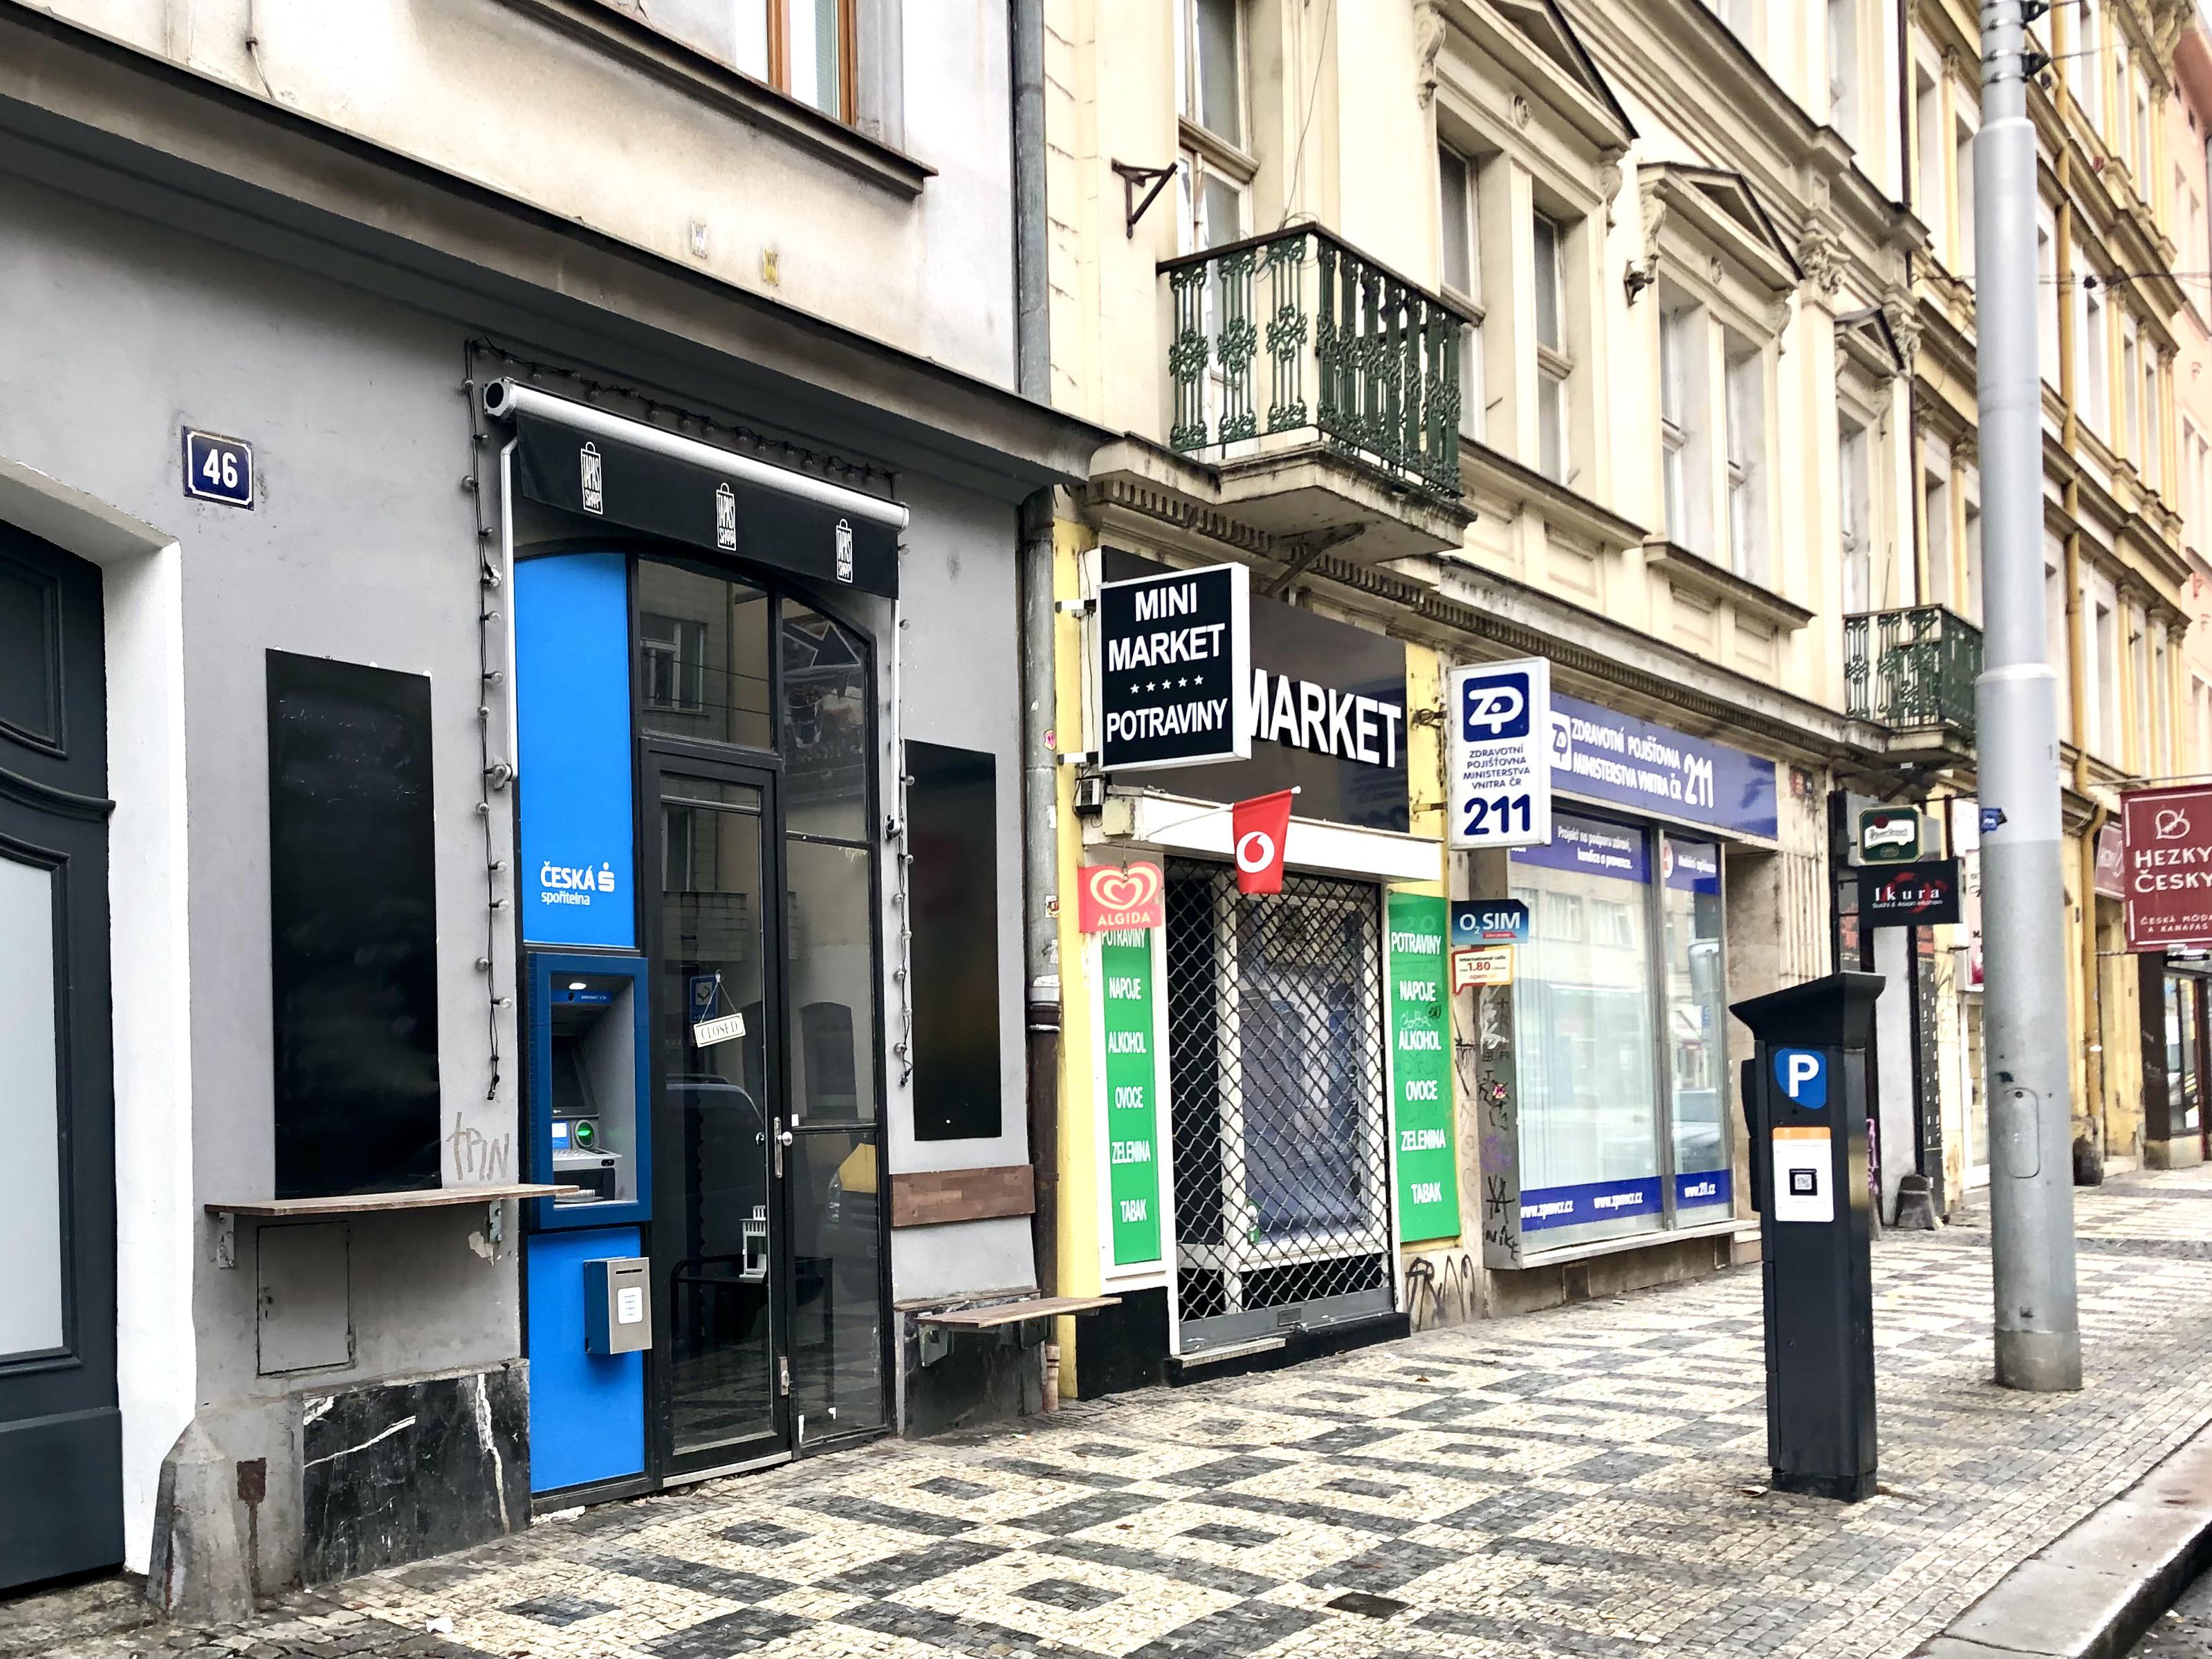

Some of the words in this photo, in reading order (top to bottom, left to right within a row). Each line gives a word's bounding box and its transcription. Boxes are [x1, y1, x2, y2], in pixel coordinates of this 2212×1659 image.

[203, 448, 239, 489] 46
[582, 454, 600, 492] TAPAS
[585, 489, 600, 508] SHOP
[717, 494, 733, 529] TAPAS
[719, 527, 734, 546] SHOP
[1135, 582, 1197, 622] MINI
[1109, 623, 1225, 672] MARKET
[1107, 698, 1228, 743] POTRAVINY
[1250, 668, 1401, 768] MARKET
[1572, 718, 1625, 754] ZDRAVOTNÍ
[1469, 743, 1524, 759] ZDRAVOTNÍ
[1463, 767, 1530, 780] MINISTERSTVA
[1467, 757, 1527, 769] POJIŠŤOVNA
[1573, 751, 1637, 789] MINISTERSTVA
[1637, 770, 1669, 797] VNITRA
[1471, 780, 1506, 790] VNITRA
[1509, 777, 1522, 786] ČR
[1684, 752, 1713, 809] 211
[1464, 794, 1530, 835] 211
[2135, 846, 2212, 868] HEZKY
[540, 860, 596, 891] ČESKÁ
[2135, 869, 2212, 893] ČESKY
[541, 891, 590, 906] spořitelna
[1874, 886, 1939, 901] Ikura
[1097, 911, 1151, 927] ALGIDA
[1482, 912, 1520, 930] SIM
[1101, 927, 1145, 948] POTRAVINY
[1391, 932, 1441, 954] POTRAVINY
[1467, 961, 1491, 972] 1.80
[1109, 976, 1141, 1000] NAPOJE
[1399, 981, 1436, 1001] NAPOJE
[701, 1021, 738, 1039] CLOSED
[1108, 1030, 1147, 1053] ALKOHOL
[1398, 1030, 1442, 1051] ALKOHOL
[1789, 1055, 1819, 1097] P
[1115, 1086, 1144, 1109] OVOCE
[1405, 1079, 1438, 1101] OVOCE
[1401, 1129, 1446, 1151] ZELENINA
[1112, 1140, 1151, 1164] ZELENINA
[1410, 1181, 1442, 1205] TABAK
[1120, 1198, 1148, 1223] TABAK
